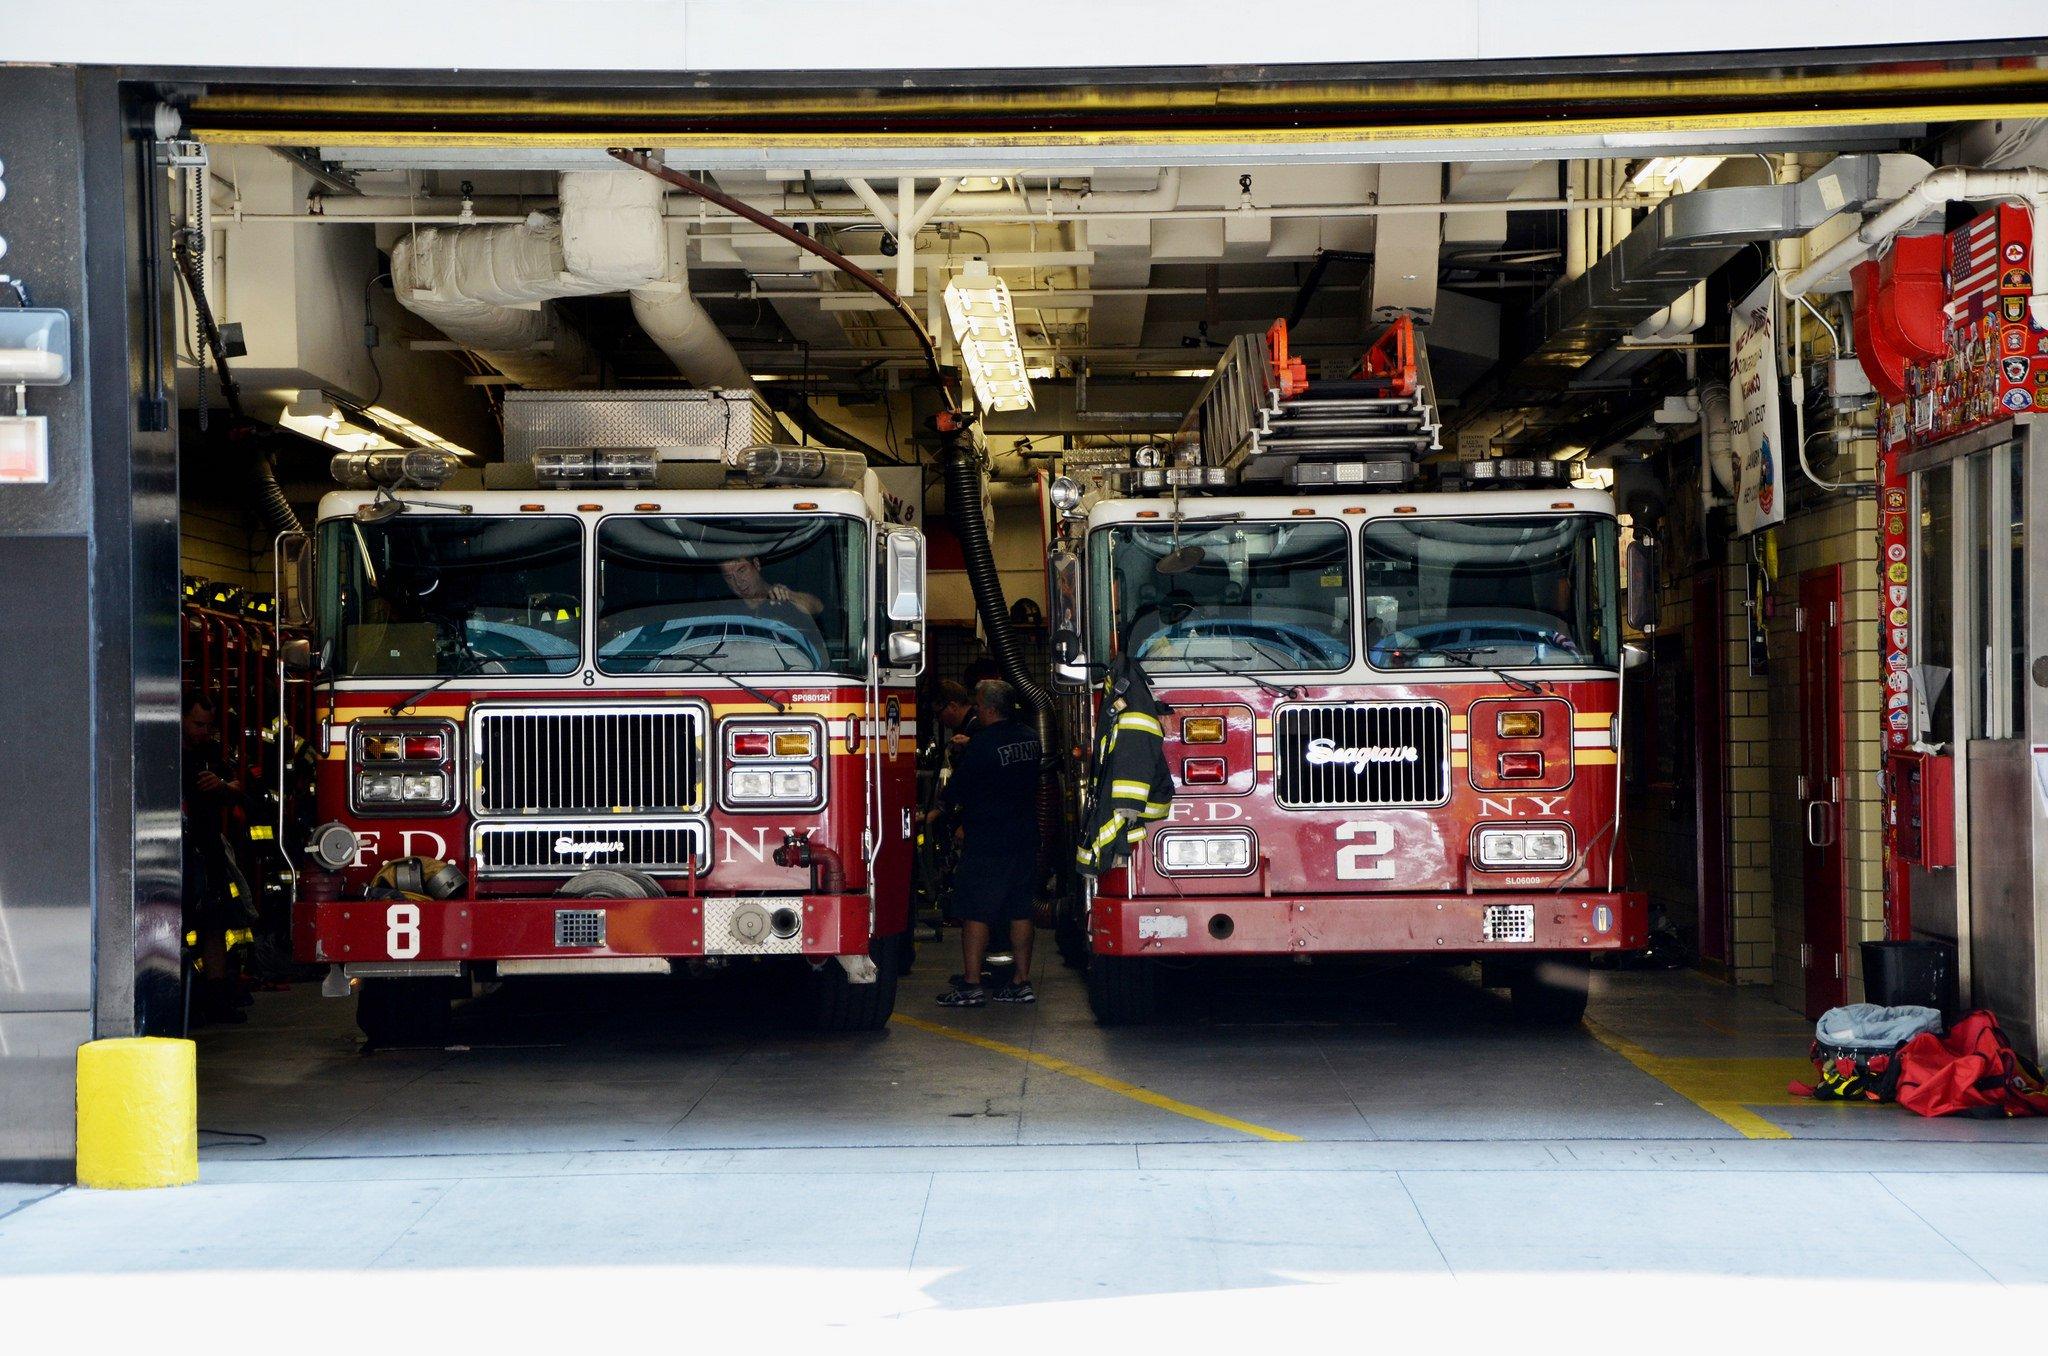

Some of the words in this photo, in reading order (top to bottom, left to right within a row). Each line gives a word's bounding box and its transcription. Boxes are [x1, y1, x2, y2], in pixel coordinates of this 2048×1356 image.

[583, 670, 595, 686] 8
[792, 693, 831, 702] SP08012H
[1306, 738, 1418, 774] Seagrave
[1164, 802, 1253, 822] F.D.
[1477, 796, 1571, 816] N.Y.
[554, 837, 625, 860] Seagrave
[1335, 820, 1396, 880] 2
[1505, 876, 1541, 885] SL06009
[386, 904, 420, 959] 8
